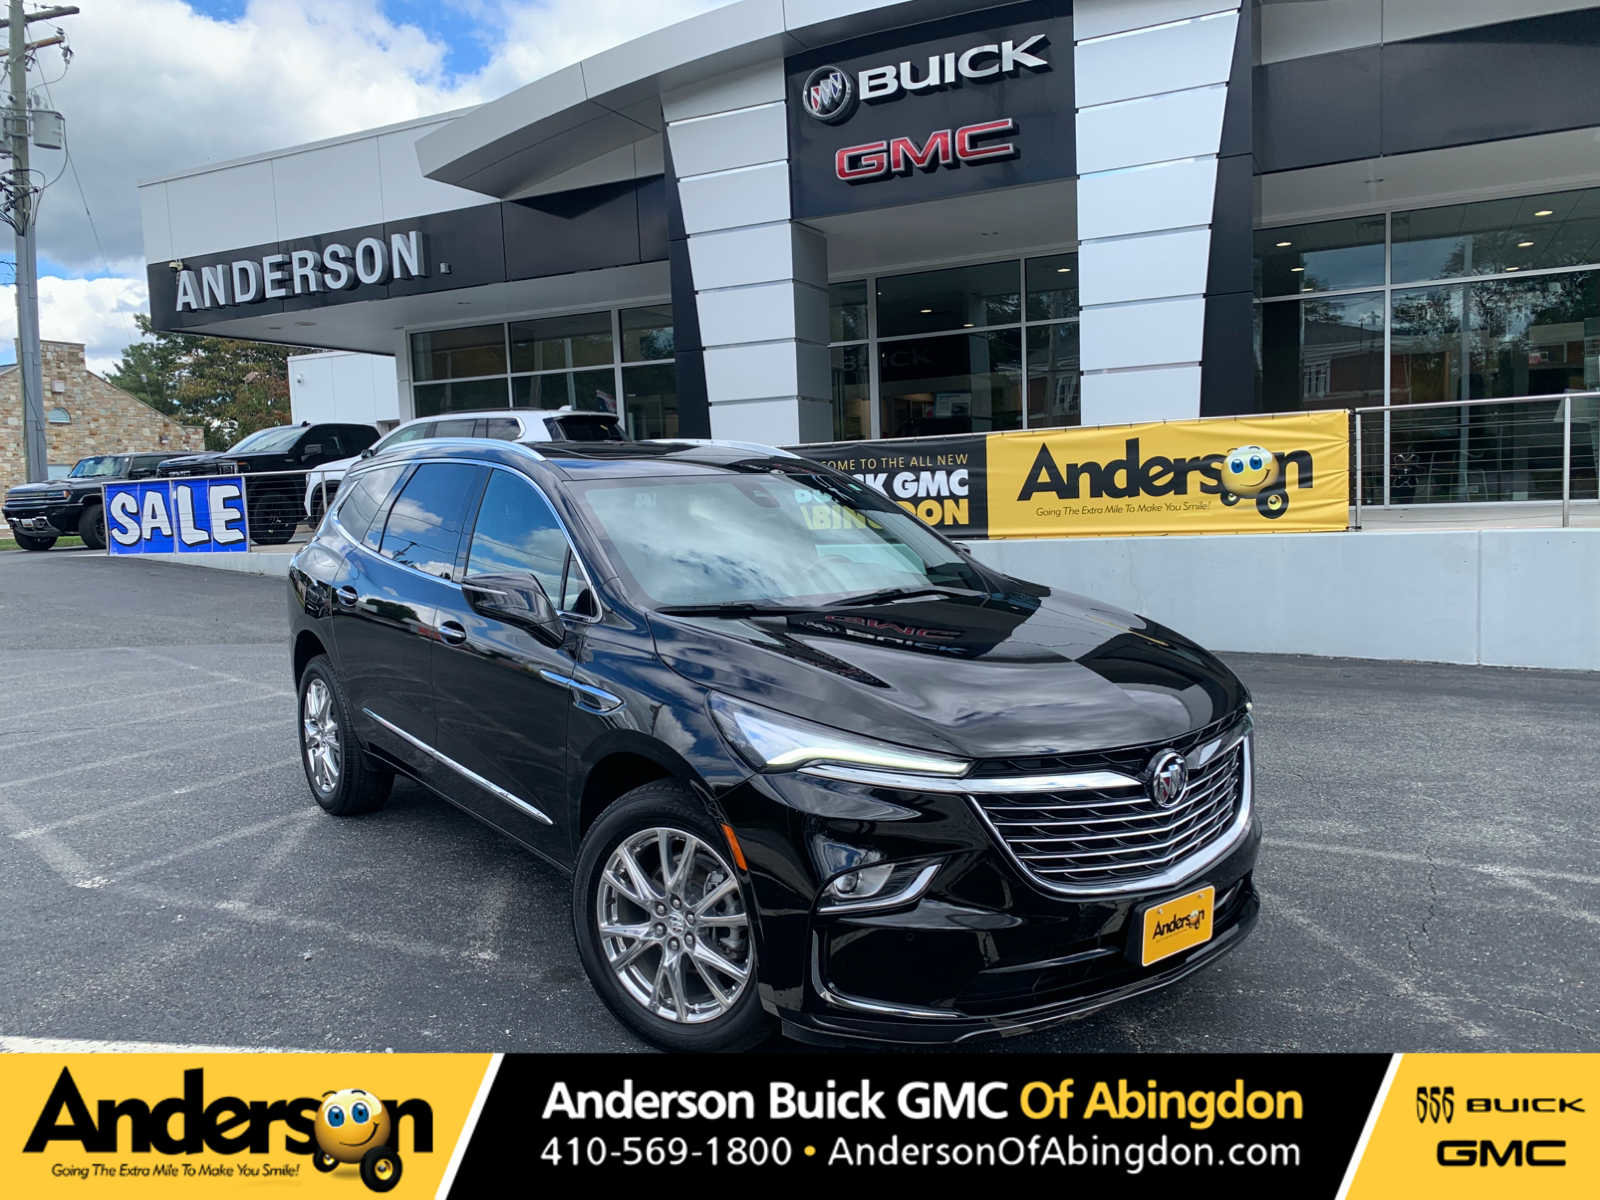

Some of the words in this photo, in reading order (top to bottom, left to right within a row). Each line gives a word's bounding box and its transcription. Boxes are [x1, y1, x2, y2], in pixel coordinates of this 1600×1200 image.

[858, 34, 1049, 100] BUICK
[835, 118, 1015, 180] GMC
[176, 231, 424, 311] ANDERSON
[860, 457, 877, 470] TO
[881, 456, 905, 469] THE
[909, 455, 934, 468] ALL
[937, 453, 968, 466] NEW
[893, 469, 969, 498] GMC
[110, 485, 245, 545] SALE
[1036, 506, 1061, 518] Going
[1063, 506, 1079, 516] The
[1081, 506, 1103, 515] Extra
[1105, 504, 1123, 514] Mile
[1125, 504, 1136, 513] To
[1137, 503, 1162, 513] Make
[1164, 502, 1182, 512] You
